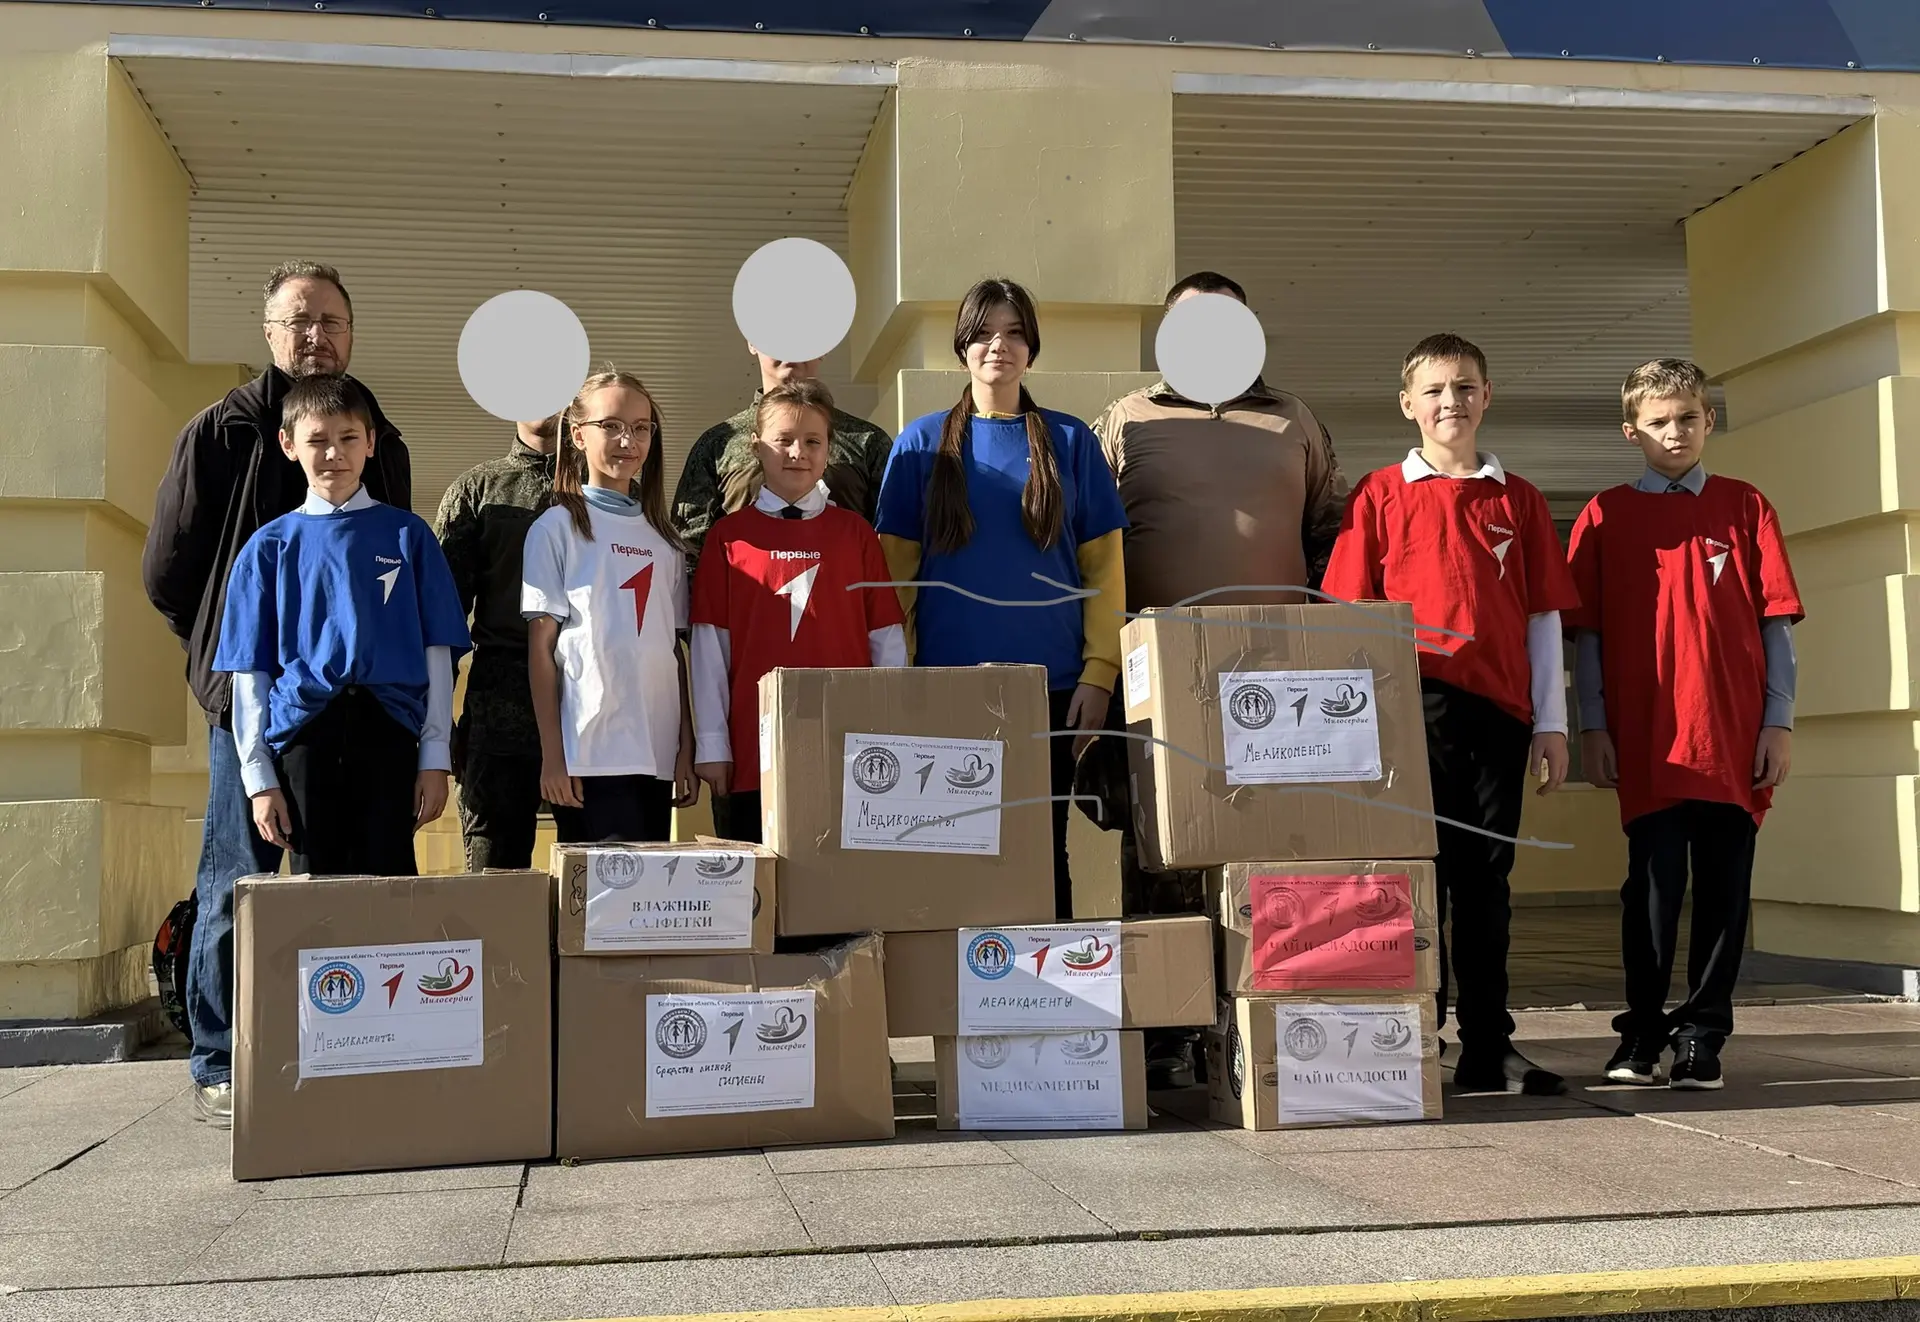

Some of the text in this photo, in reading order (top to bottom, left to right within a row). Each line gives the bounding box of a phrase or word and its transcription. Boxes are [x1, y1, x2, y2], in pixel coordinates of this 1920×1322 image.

[610, 543, 653, 558] Первые
[770, 550, 821, 561] Первые
[375, 555, 402, 565] Первые
[1323, 717, 1369, 726] Милосердие
[946, 787, 993, 797] Милосердие
[632, 900, 712, 913] ВЛАЖНЫЕ
[629, 916, 712, 929] САЛФЕТКИ
[379, 962, 405, 970] Первые
[1064, 970, 1113, 978] Милосердие
[419, 995, 474, 1005] Милосердие
[757, 1042, 807, 1052] Милосердие
[1294, 1071, 1322, 1085] ЧАЙ
[1326, 1073, 1335, 1084] И
[1337, 1069, 1408, 1084] СЛАДОСТИ
[981, 1079, 1100, 1094] МЕДИКАМЕНТЫ
